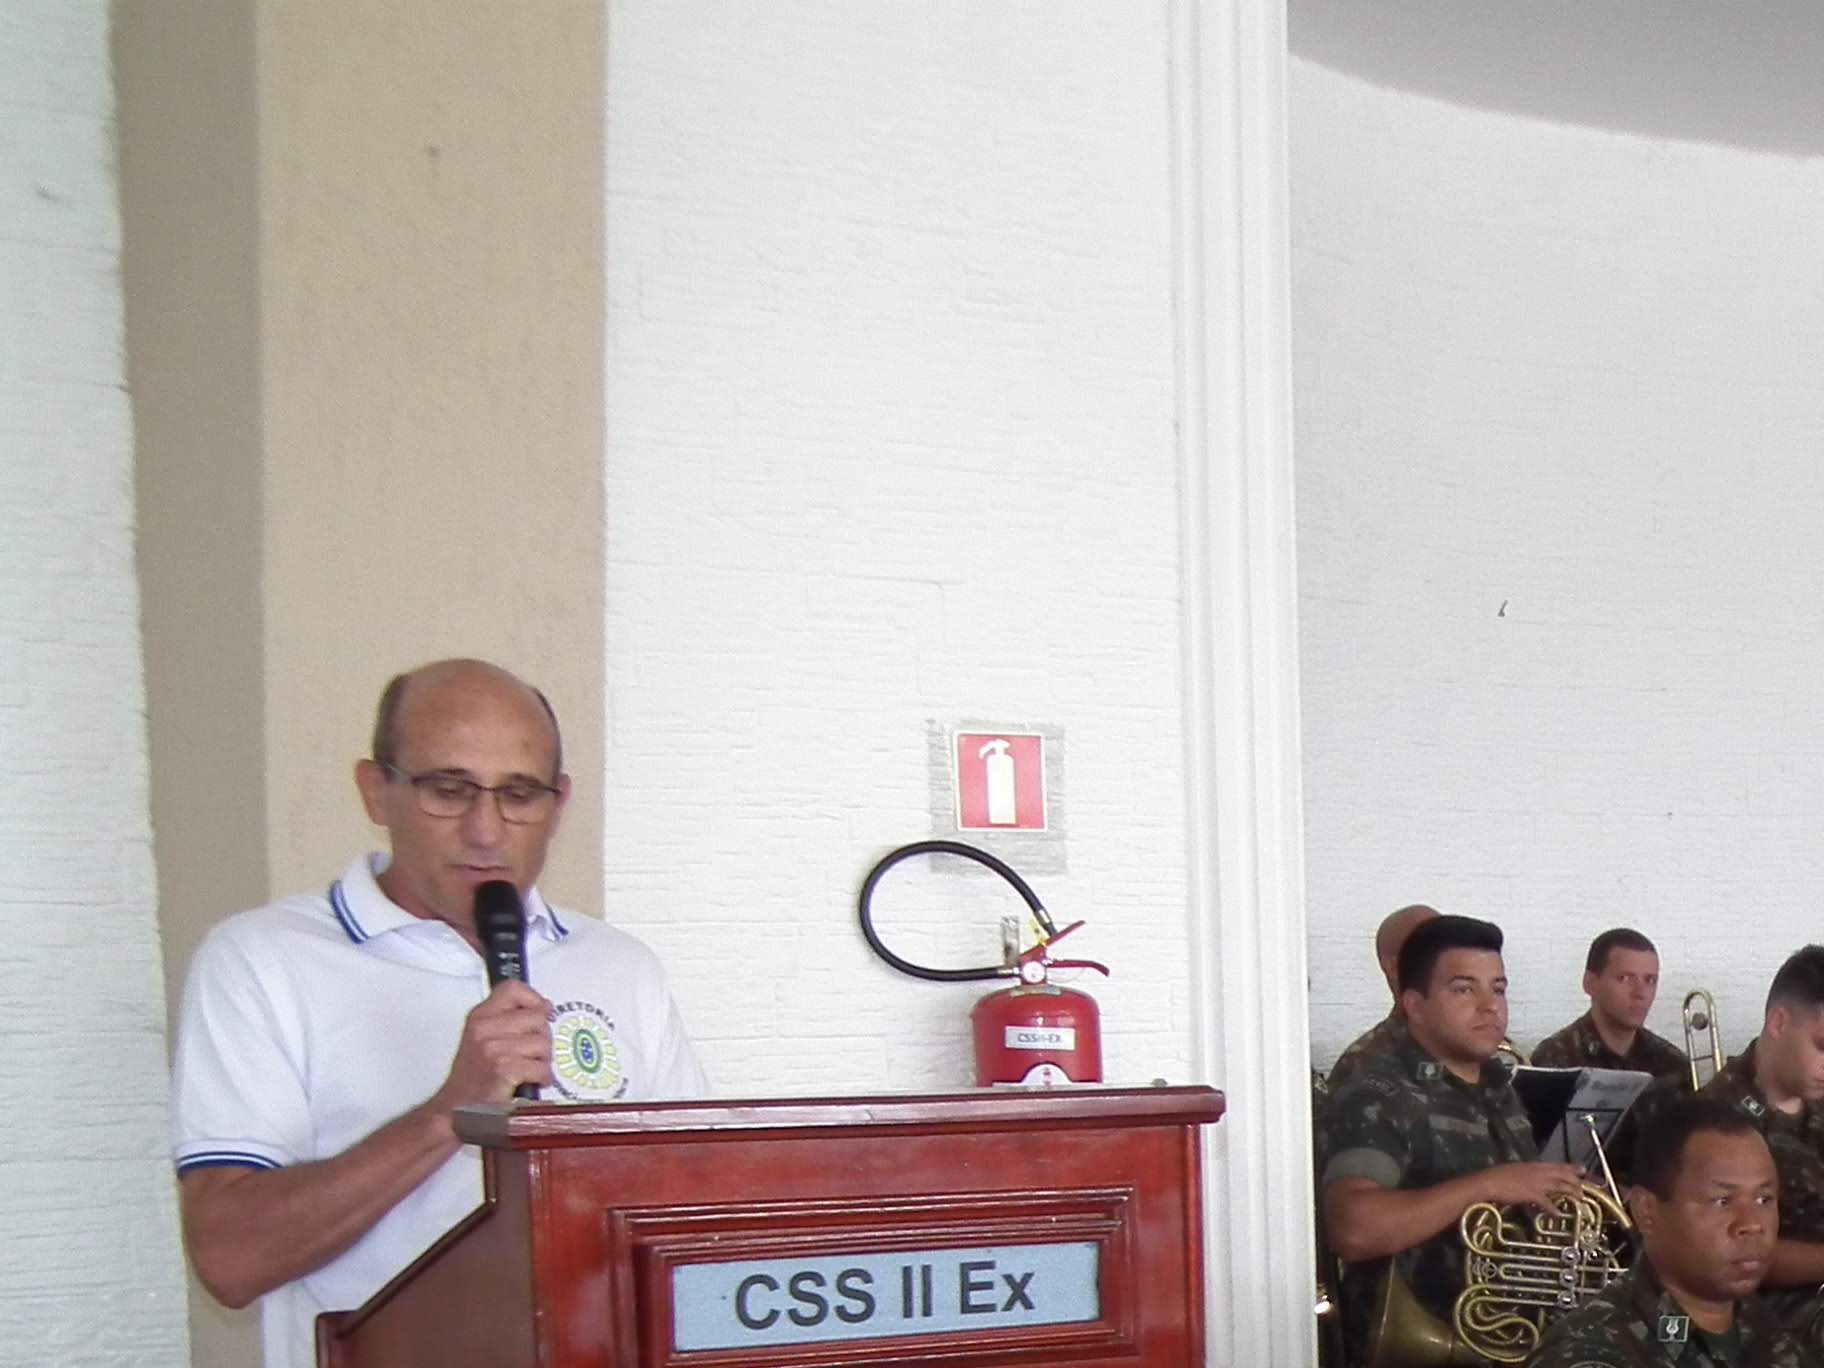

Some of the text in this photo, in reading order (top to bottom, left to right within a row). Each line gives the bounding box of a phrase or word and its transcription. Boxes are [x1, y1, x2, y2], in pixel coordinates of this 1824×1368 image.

[734, 1260, 1036, 1331] CSS II Ex
